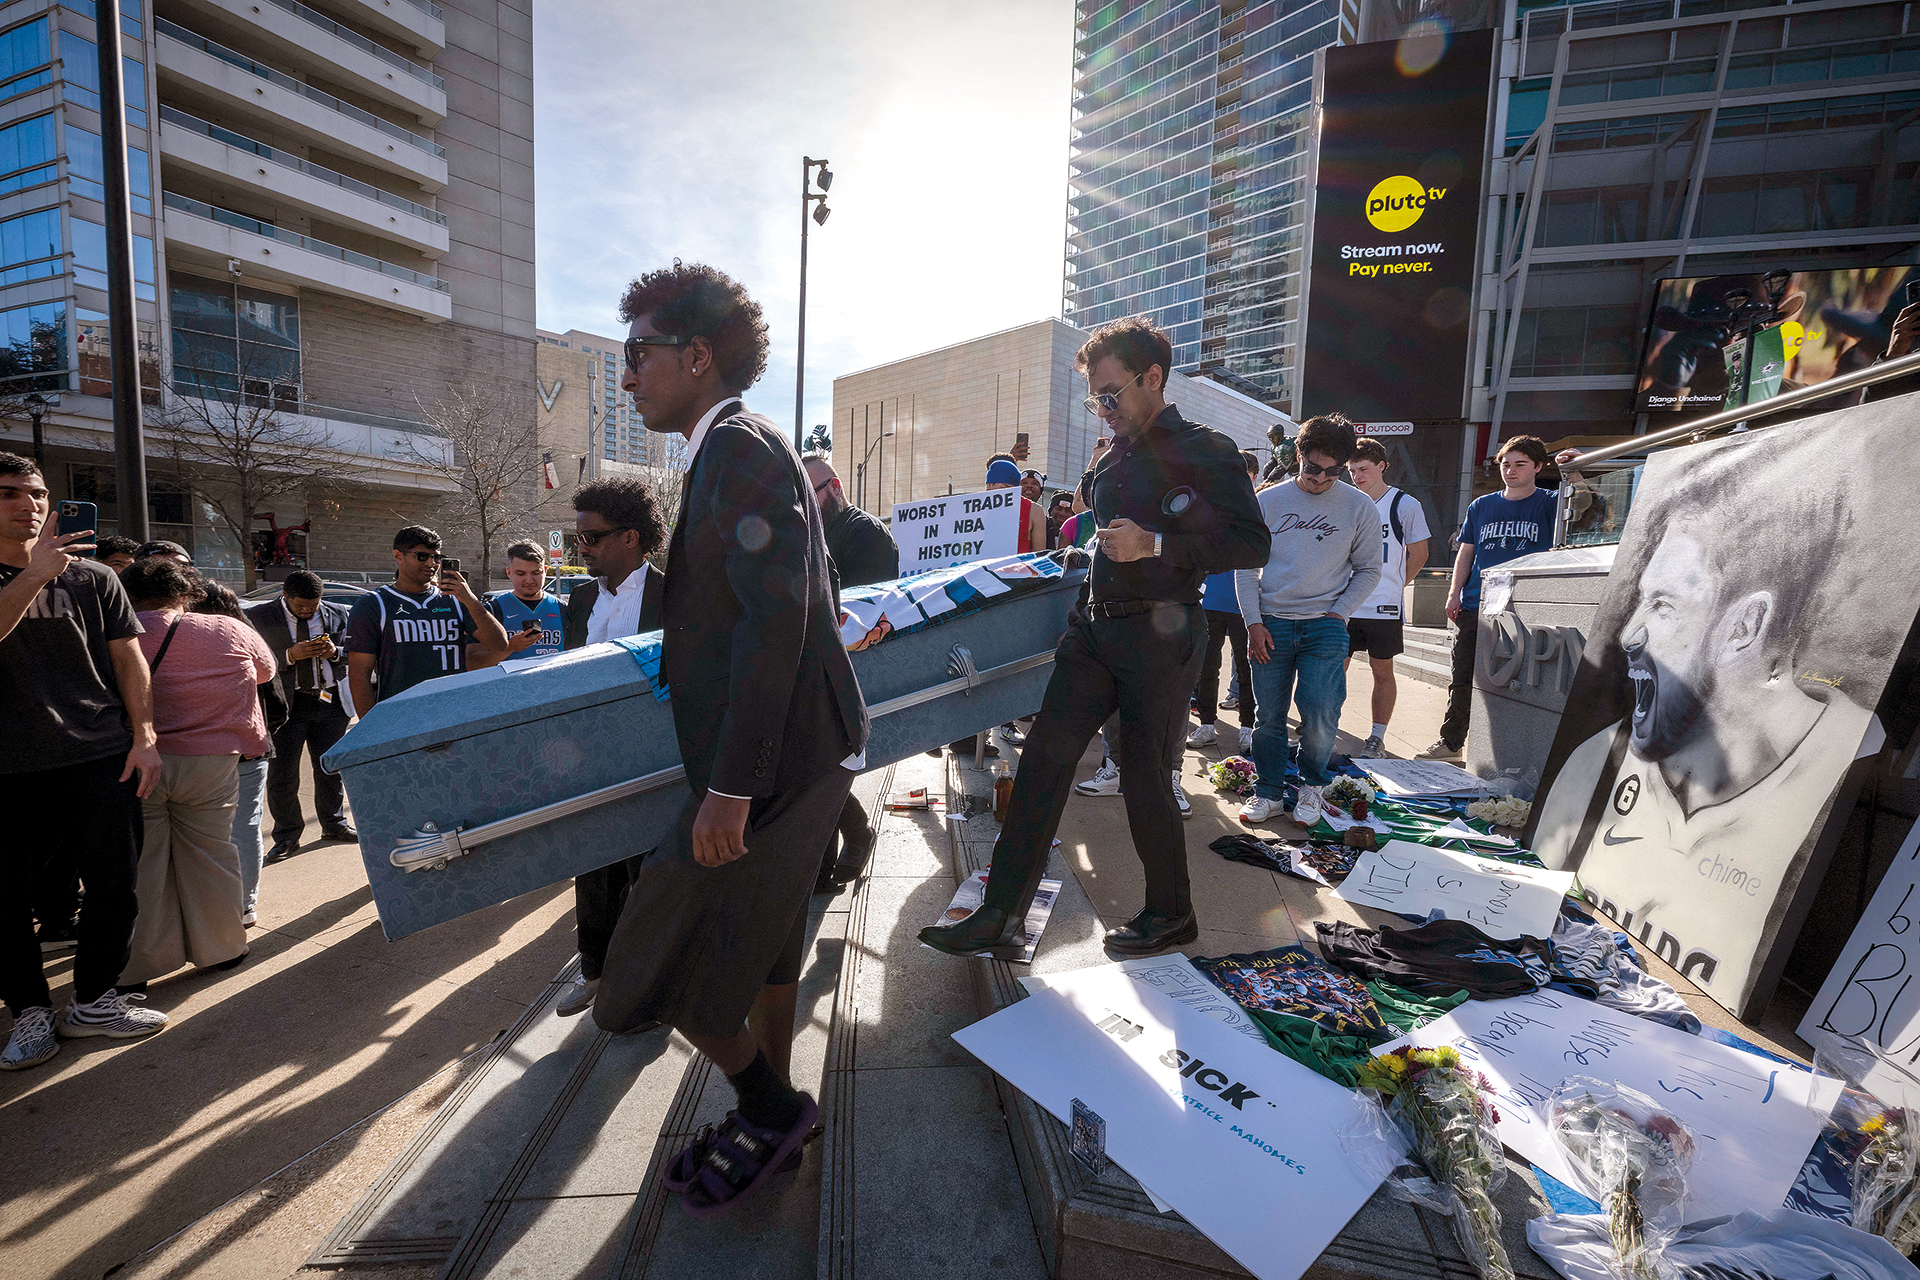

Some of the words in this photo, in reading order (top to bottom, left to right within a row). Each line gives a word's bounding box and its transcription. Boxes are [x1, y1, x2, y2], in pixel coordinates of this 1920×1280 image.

[1369, 193, 1427, 216] pluto
[1428, 186, 1447, 200] tv
[1340, 245, 1402, 259] Stream
[1405, 242, 1445, 255] now.
[1349, 261, 1381, 278] Pay
[1383, 261, 1433, 274] never.
[1648, 395, 1678, 404] Django
[1678, 394, 1723, 403] Unchained
[1367, 424, 1411, 433] OUTDOOR
[898, 502, 947, 523] WORST
[963, 491, 1014, 514] TRADE
[923, 524, 939, 540] IN
[953, 517, 985, 534] NBA
[1271, 512, 1340, 536] Dallas
[1479, 520, 1539, 544] HALLELUKA
[918, 540, 984, 561] HISTORY
[393, 619, 460, 643] MAVS
[432, 645, 460, 670] 77
[1617, 778, 1639, 813] 6
[1358, 854, 1417, 904] NIC
[1697, 853, 1762, 897] chime
[1229, 1123, 1306, 1176] MAHOMES
